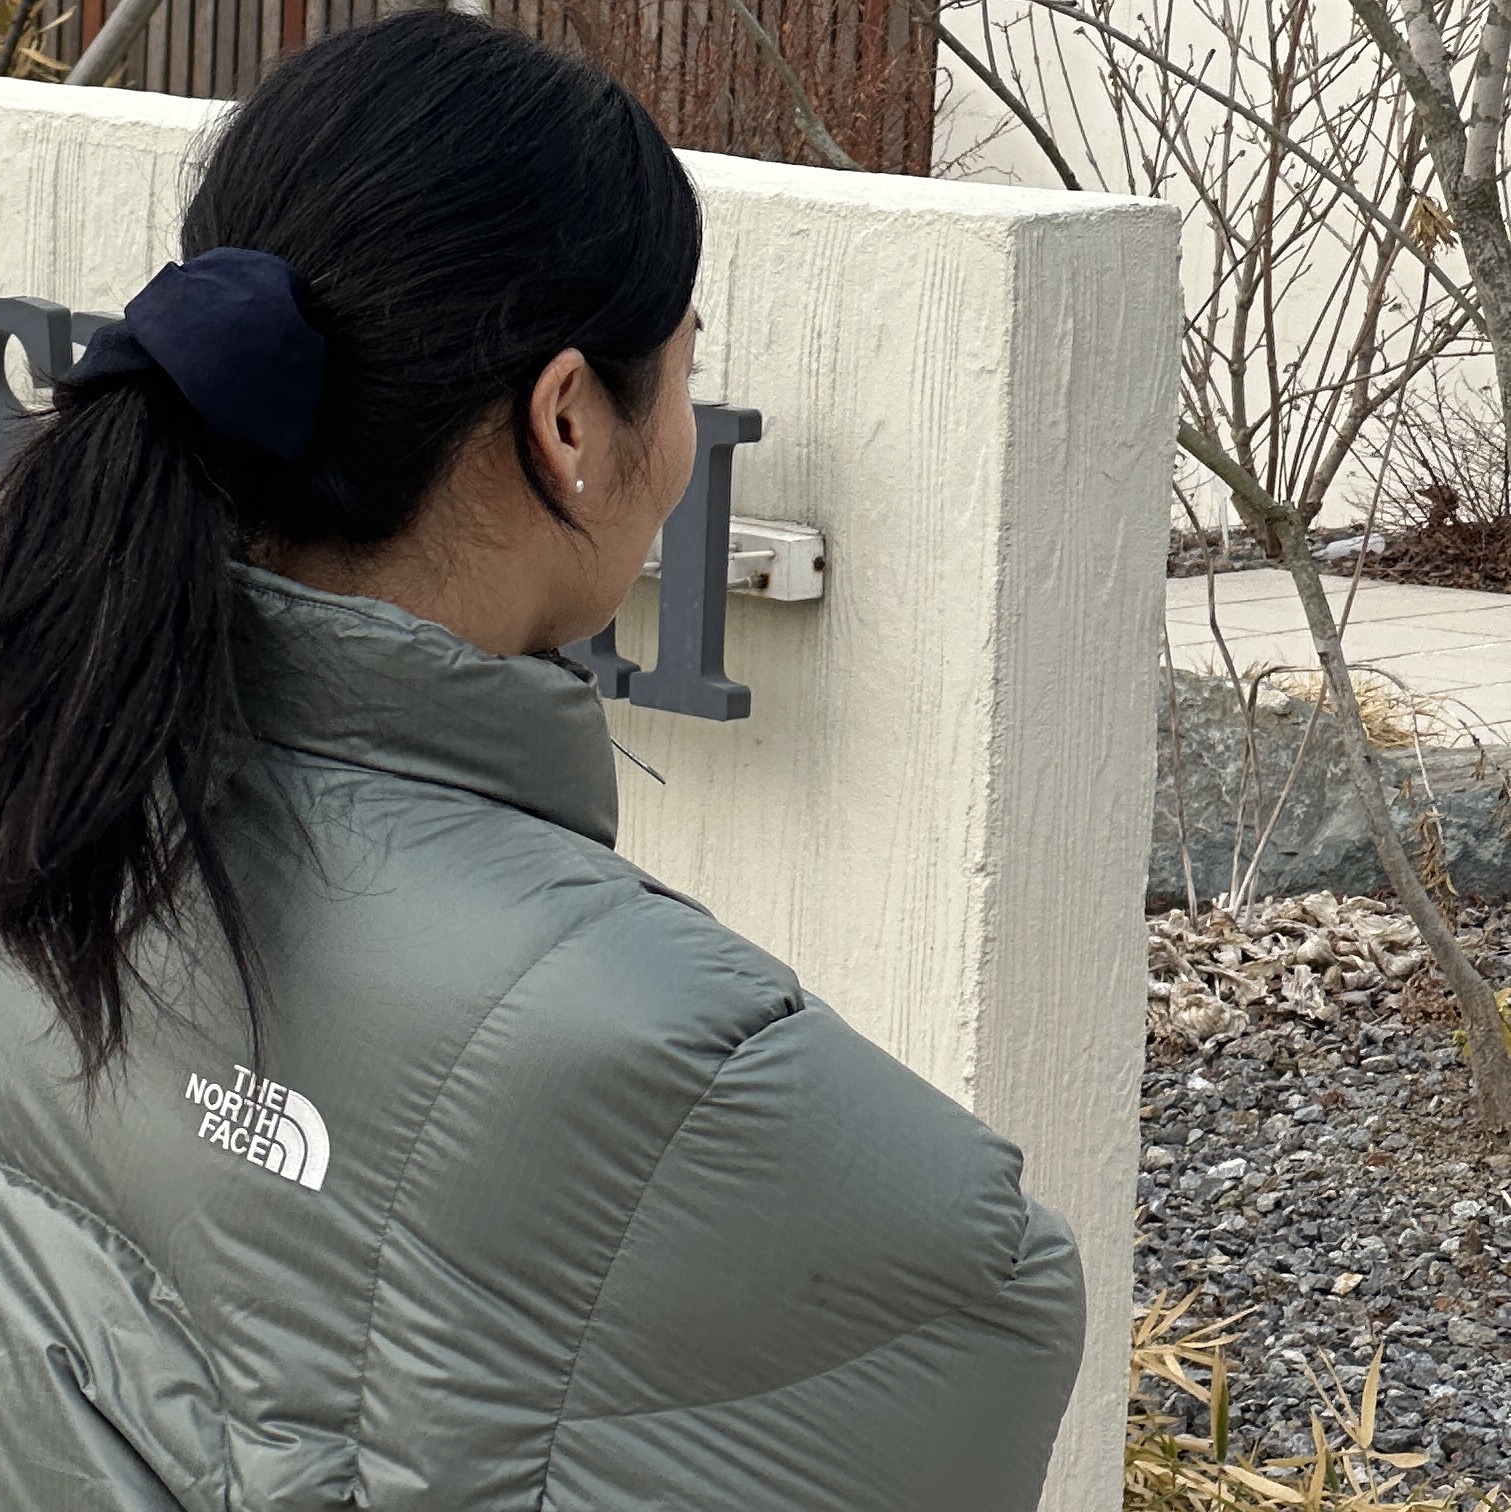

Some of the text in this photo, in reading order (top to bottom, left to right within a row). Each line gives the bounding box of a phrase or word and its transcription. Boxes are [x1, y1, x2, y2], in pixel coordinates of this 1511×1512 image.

[185, 1073, 280, 1139] NORTH
[234, 1064, 288, 1112] THE
[198, 1111, 272, 1167] FACE
